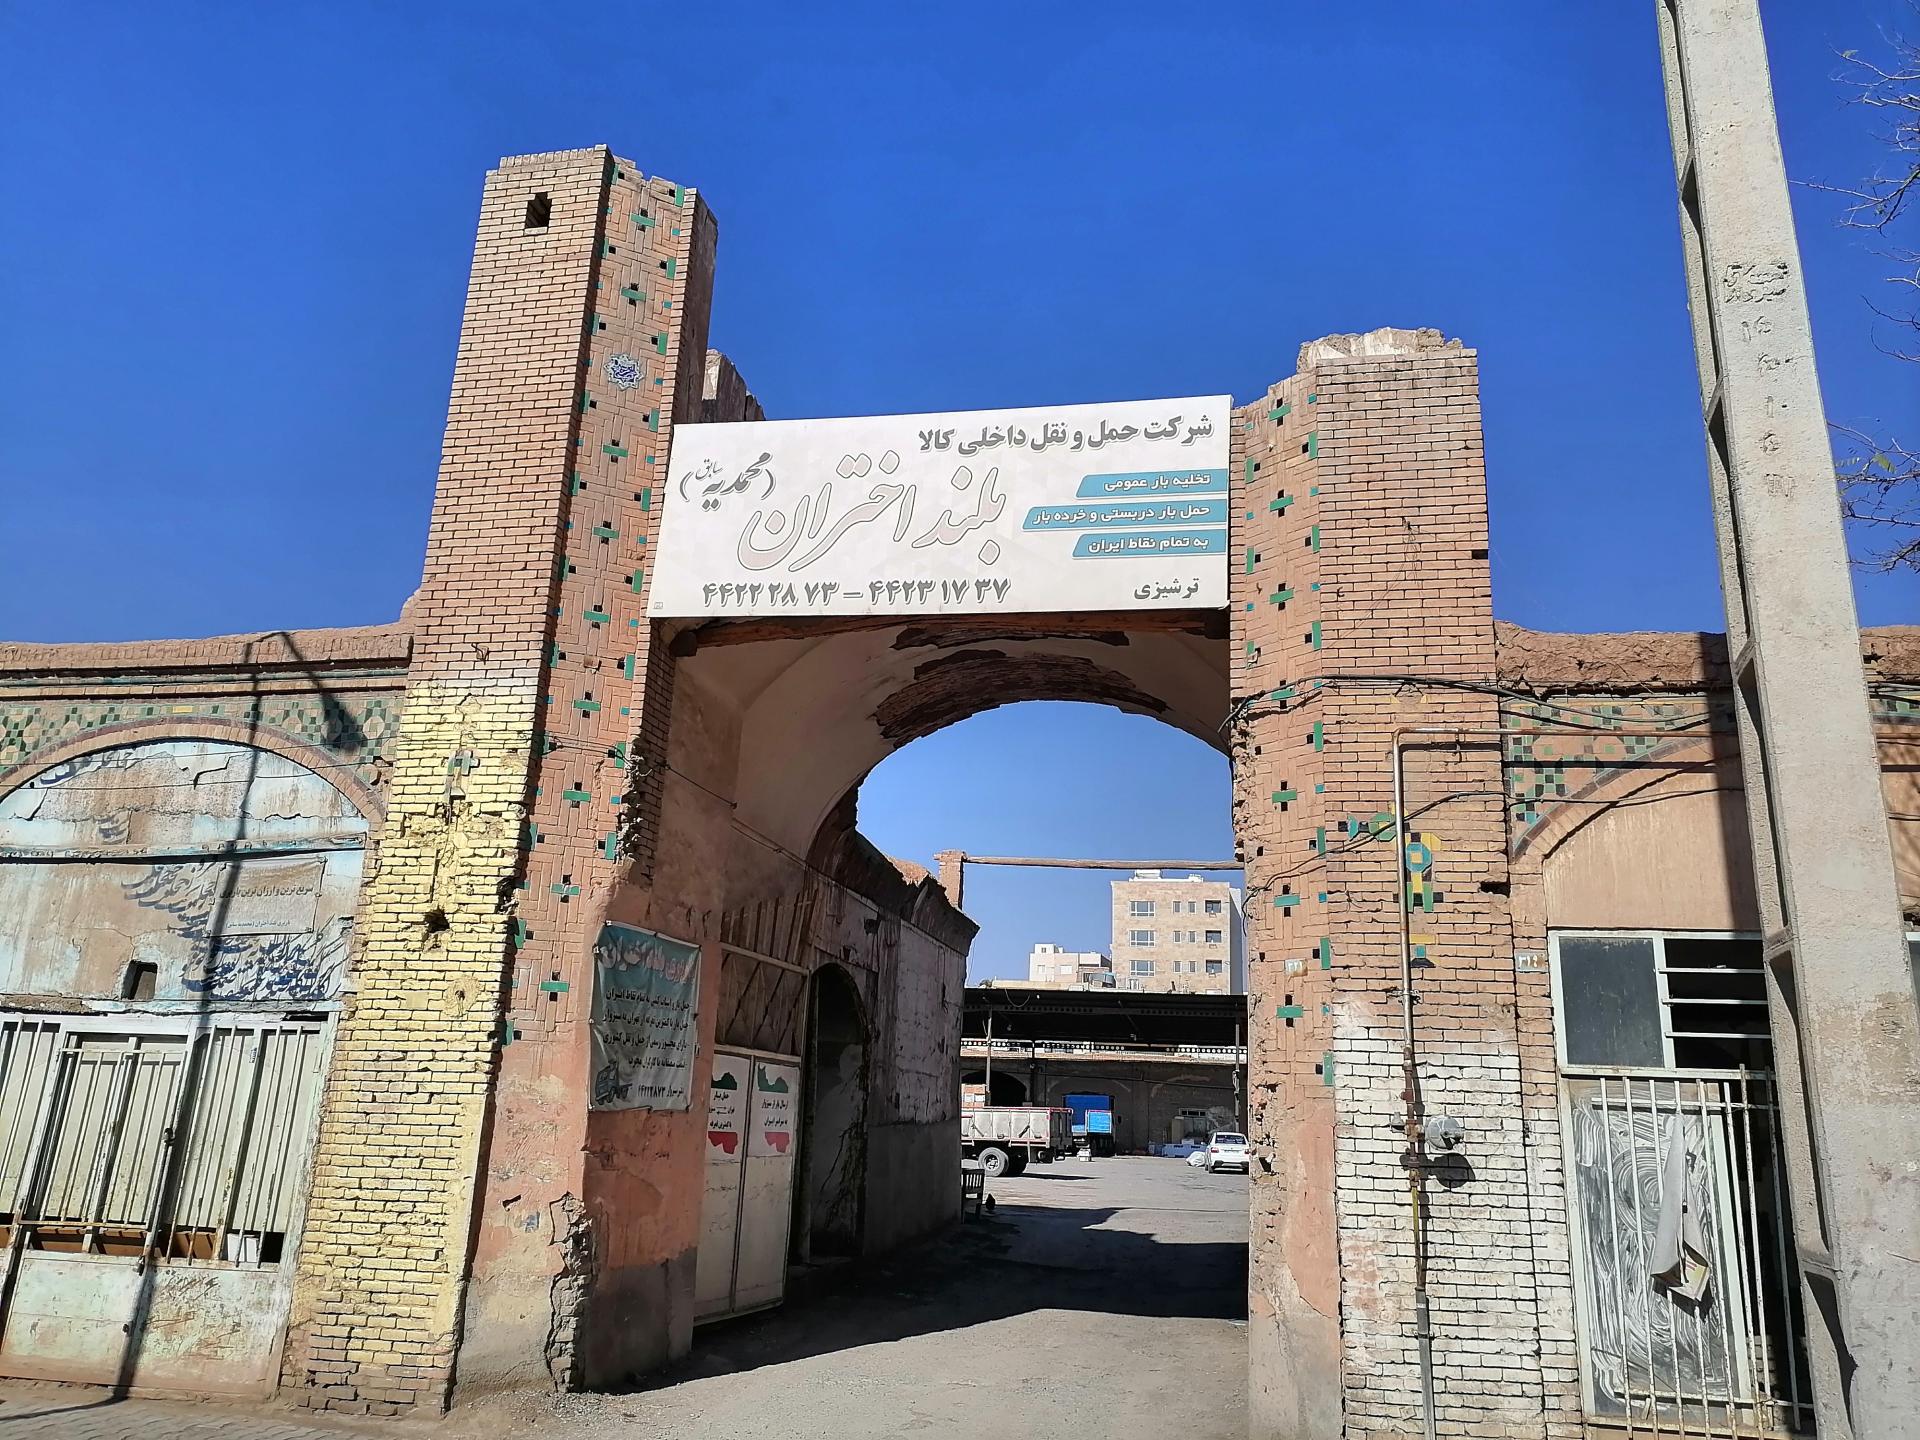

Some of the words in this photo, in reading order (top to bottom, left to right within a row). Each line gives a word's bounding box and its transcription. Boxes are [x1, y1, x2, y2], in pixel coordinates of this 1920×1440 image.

[1030, 421, 1067, 451] نقل
[1087, 419, 1139, 448] حمل
[1143, 414, 1212, 444] شرکت
[919, 428, 955, 451] کالا
[958, 424, 1027, 455] داخلی
[1069, 430, 1083, 450] و
[1104, 478, 1148, 492] عمومی
[1151, 475, 1169, 489] بار
[1172, 473, 1211, 488] تخلیه
[737, 449, 917, 572] اختران
[911, 466, 1006, 565] بلند
[1032, 510, 1051, 525] بار
[1054, 507, 1086, 522] خرده
[1089, 511, 1098, 522] و
[1100, 506, 1155, 521] دربستی
[1158, 505, 1177, 520] بار
[1180, 504, 1210, 519] حمل
[1088, 538, 1125, 553] ایران
[1128, 537, 1156, 549] نقاط
[1159, 536, 1190, 551] تمام
[1193, 537, 1209, 549] به
[1134, 578, 1200, 600] ترشیزی
[606, 988, 625, 1001] ایران
